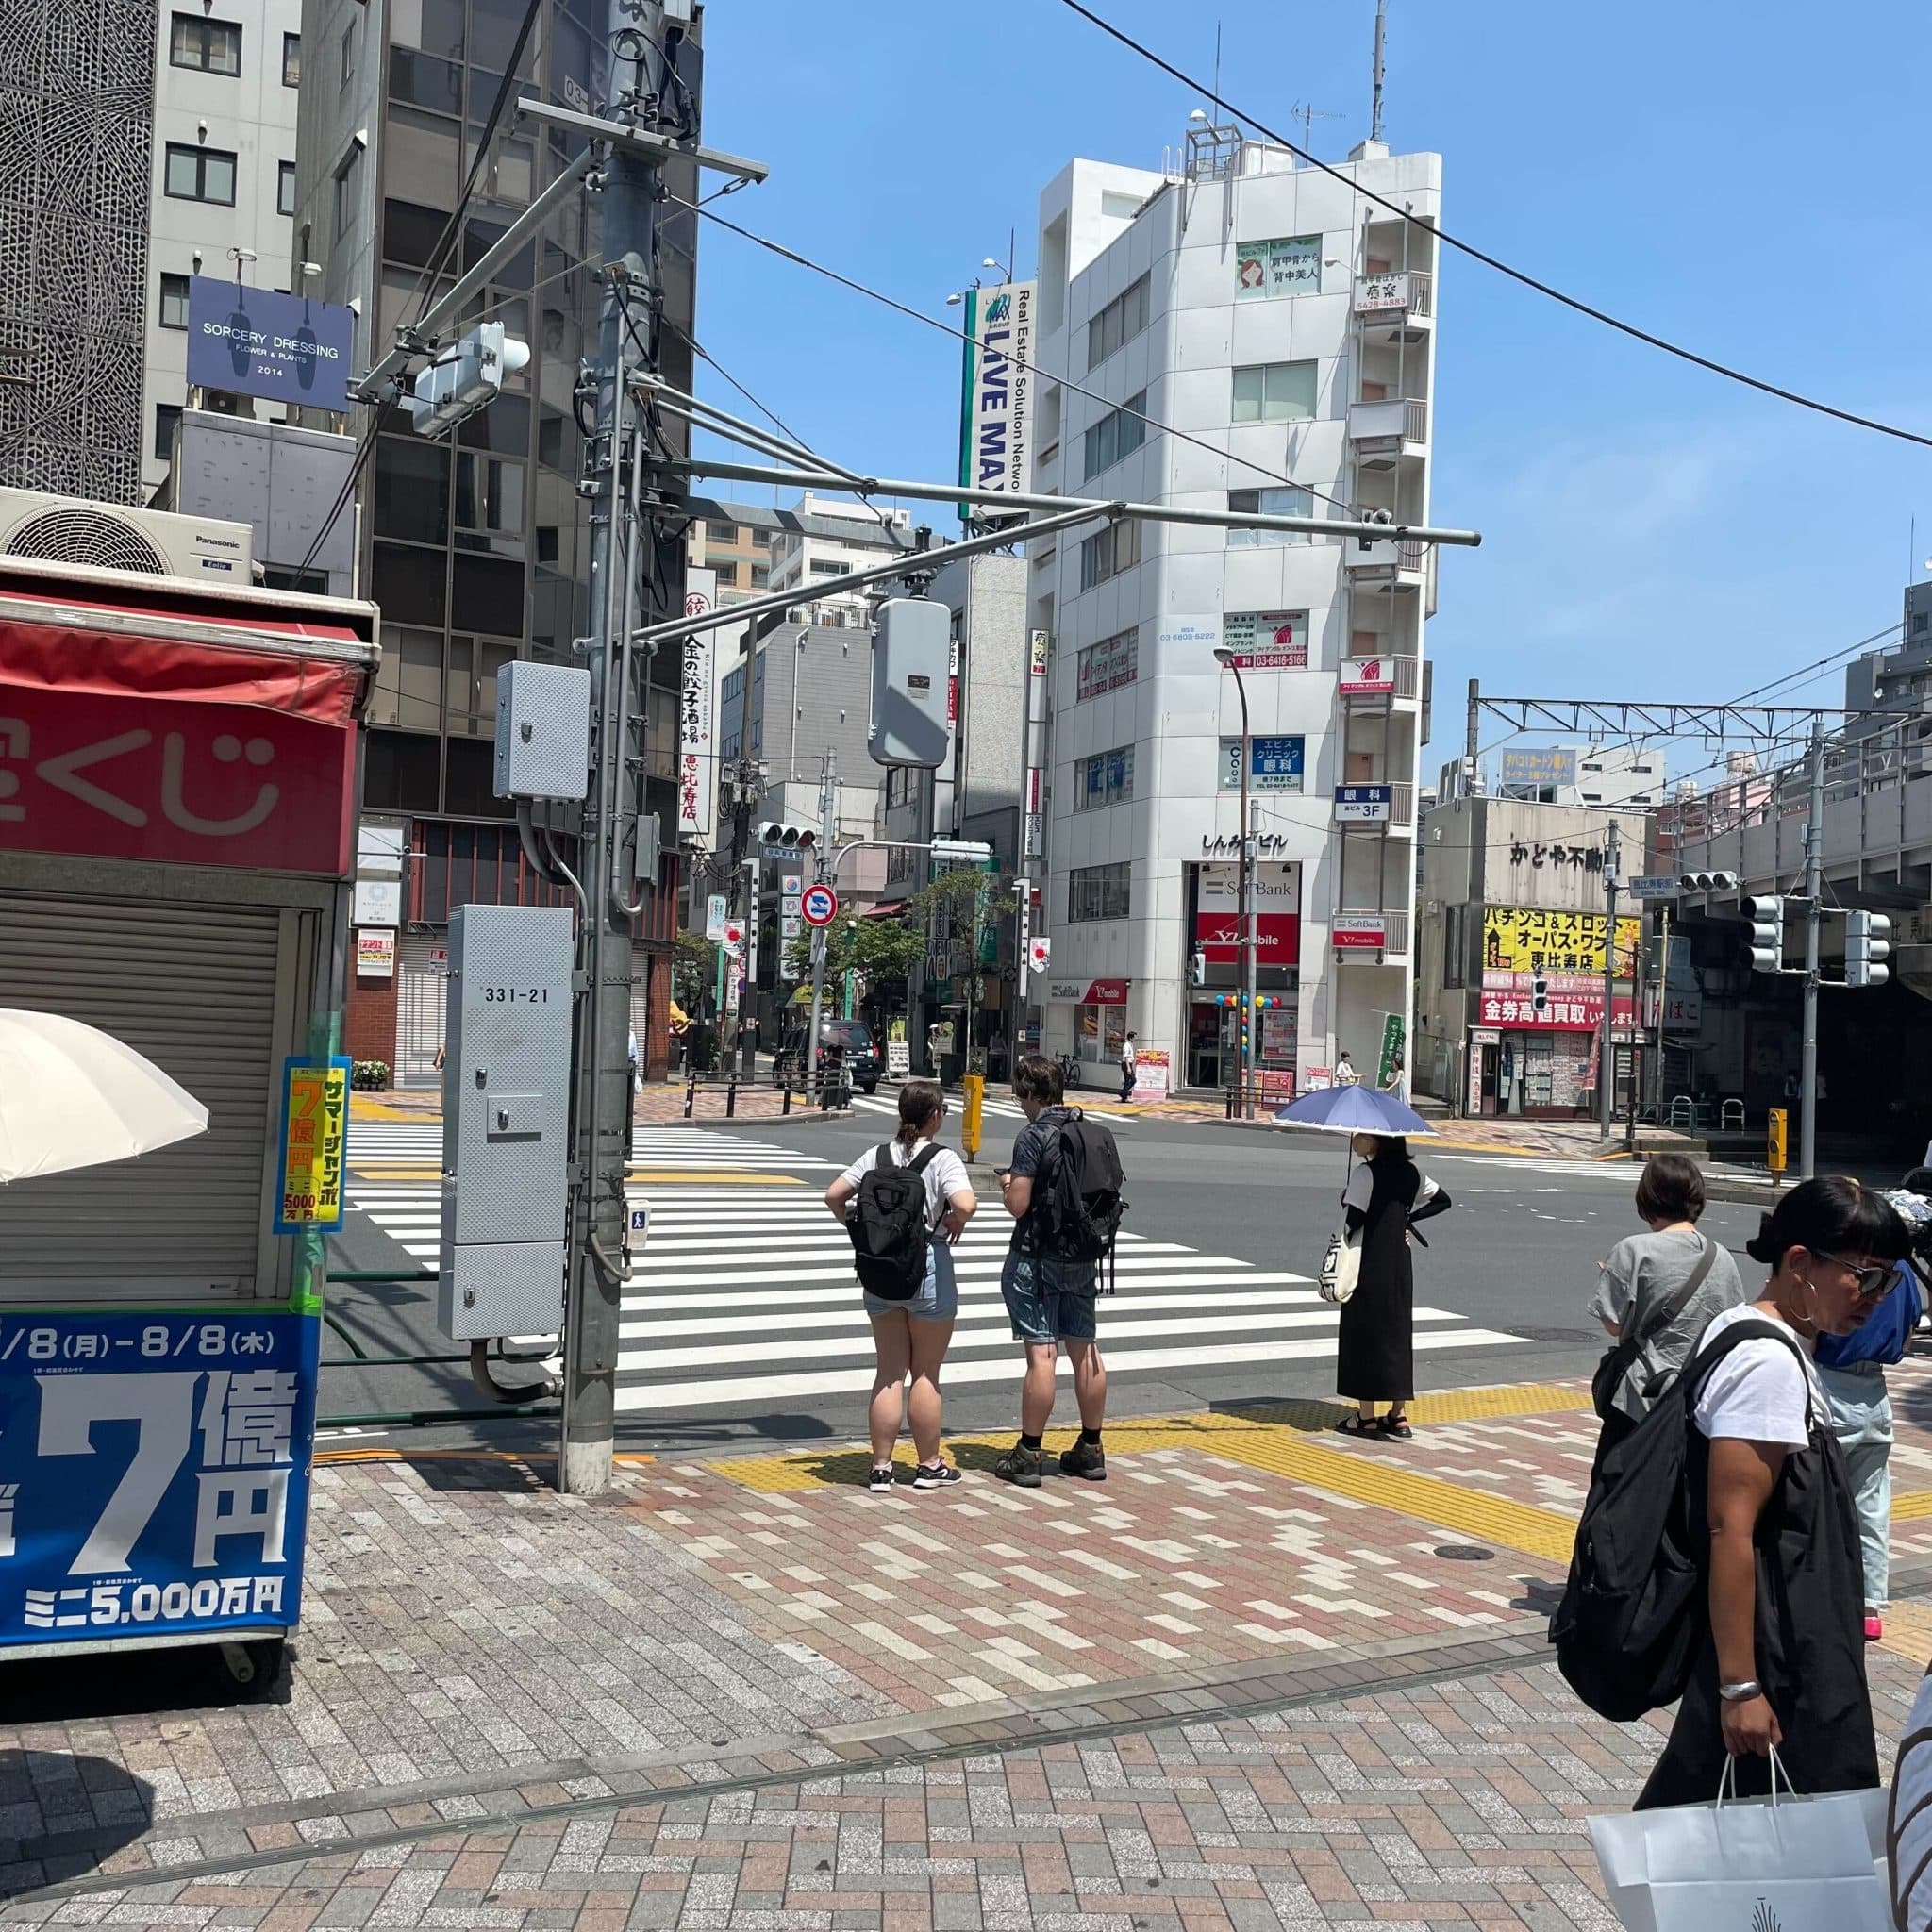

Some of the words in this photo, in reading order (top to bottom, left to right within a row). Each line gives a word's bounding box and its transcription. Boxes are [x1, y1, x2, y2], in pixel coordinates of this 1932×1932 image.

[1274, 268, 1318, 283] 背中美人
[1018, 290, 1029, 323] Real
[203, 323, 267, 344] SORCERY
[274, 336, 339, 359] DRESSING
[236, 343, 267, 357] FLOWER
[278, 352, 307, 364] PLANTS
[1016, 327, 1028, 374] Estate
[258, 365, 283, 376] 2014
[1013, 378, 1026, 439] Solution
[1011, 443, 1024, 493] Netwo
[195, 535, 241, 549] Panasonic
[683, 635, 706, 744] 金の餃子酒場
[1264, 740, 1292, 749] エビス
[1257, 750, 1299, 758] クリニック
[1264, 758, 1291, 772] 眼科
[0, 717, 279, 836] くじ
[681, 755, 699, 819] 恵比寿店
[1344, 789, 1380, 801] 眼科
[1203, 834, 1289, 849] しんみビル
[1227, 881, 1291, 895] SfBank
[1347, 919, 1382, 928] SoftBank
[1215, 930, 1279, 946] Y!bile
[1341, 935, 1376, 944] Y!mobile
[1531, 951, 1593, 969] 恵比寿店
[485, 988, 548, 1003] 331-21
[288, 1080, 324, 1174] 7億円
[319, 1080, 343, 1206] サマージャンボ
[285, 1193, 316, 1209] 5000
[285, 1209, 314, 1220] 万円
[25, 1575, 286, 1628] ミニ5,000万円
